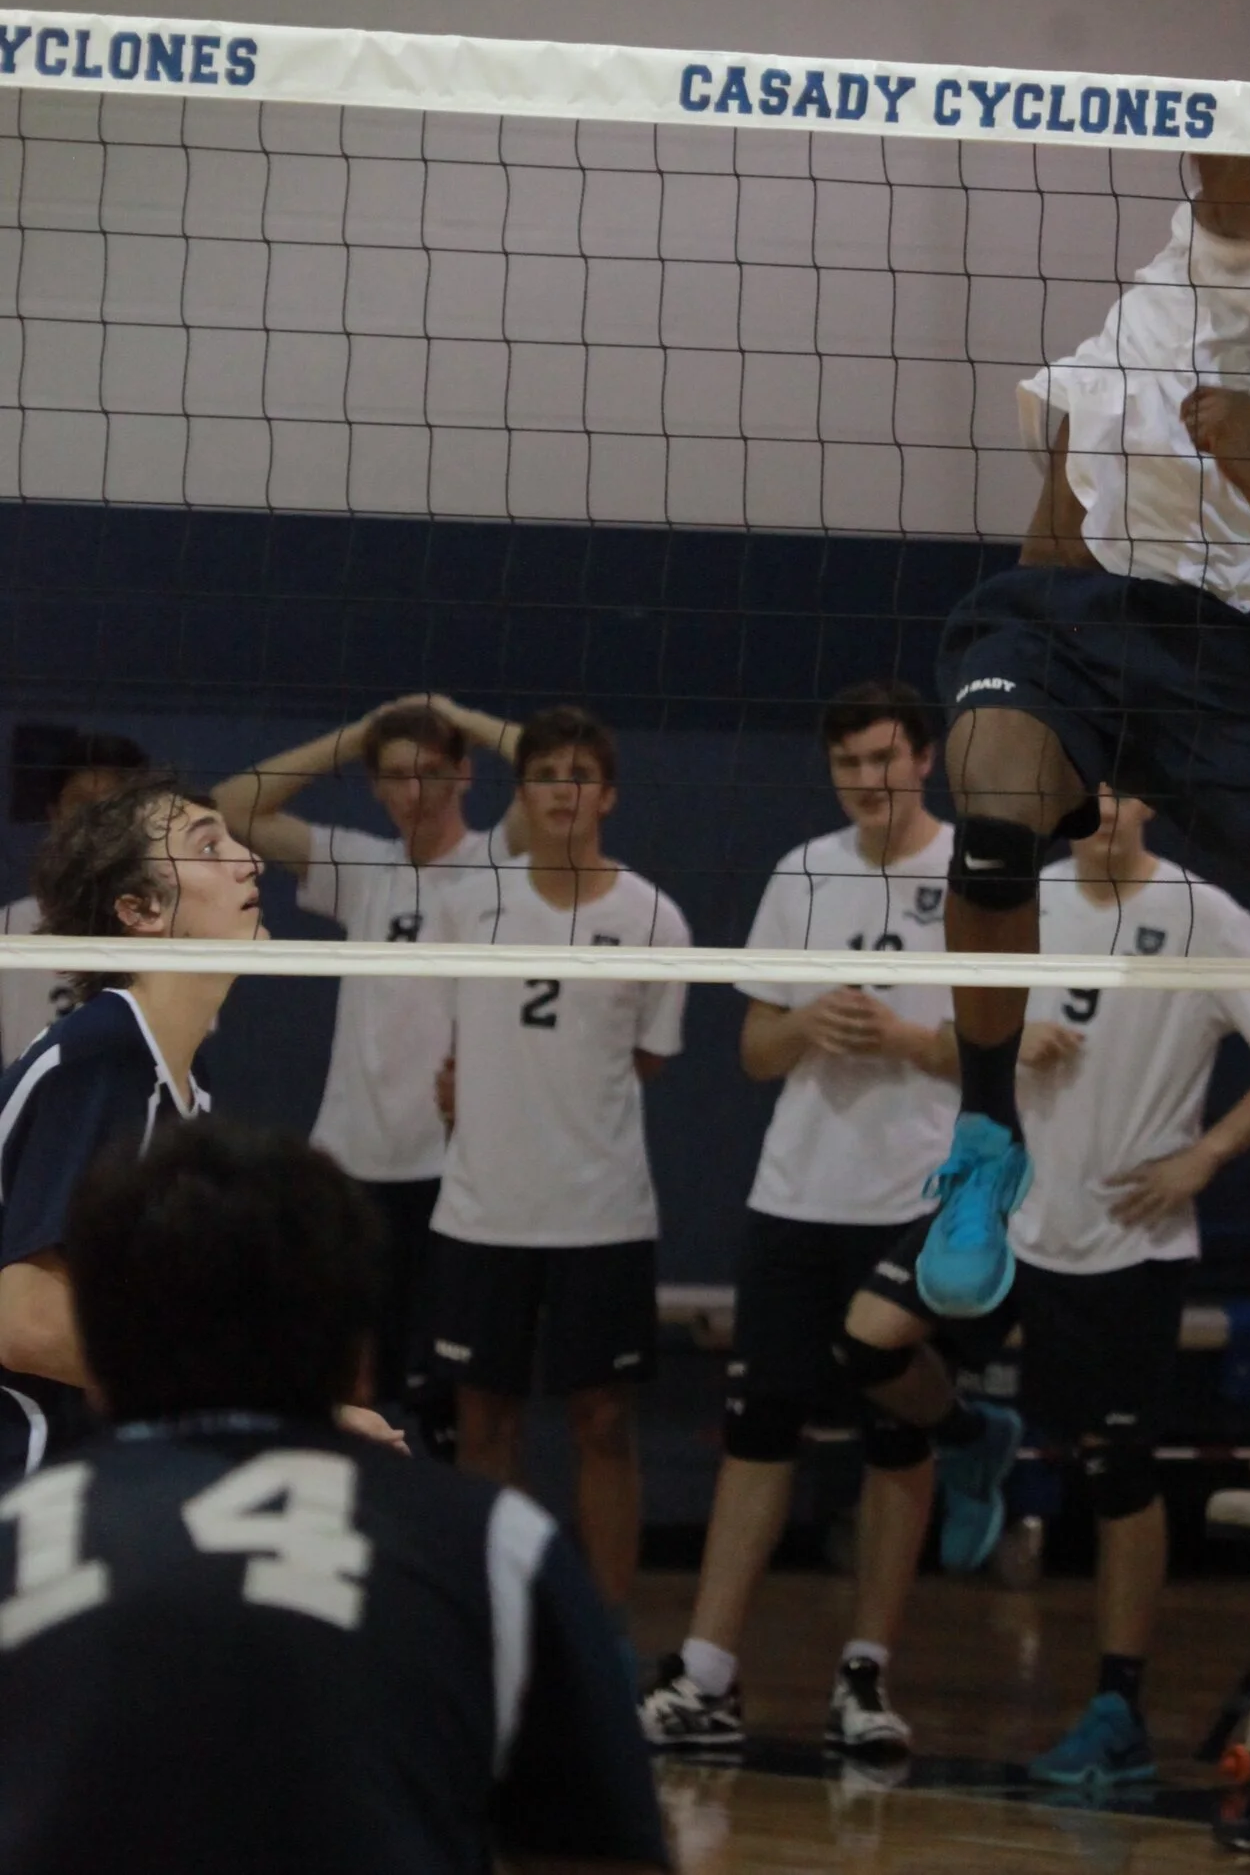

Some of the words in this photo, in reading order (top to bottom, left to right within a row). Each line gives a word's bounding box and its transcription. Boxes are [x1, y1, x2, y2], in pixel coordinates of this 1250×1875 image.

[0, 27, 258, 86] YCLONES
[679, 64, 916, 123] CASADY
[934, 79, 1218, 140] CYCLONES
[522, 978, 560, 1028] 2
[0, 1446, 374, 1651] 14
